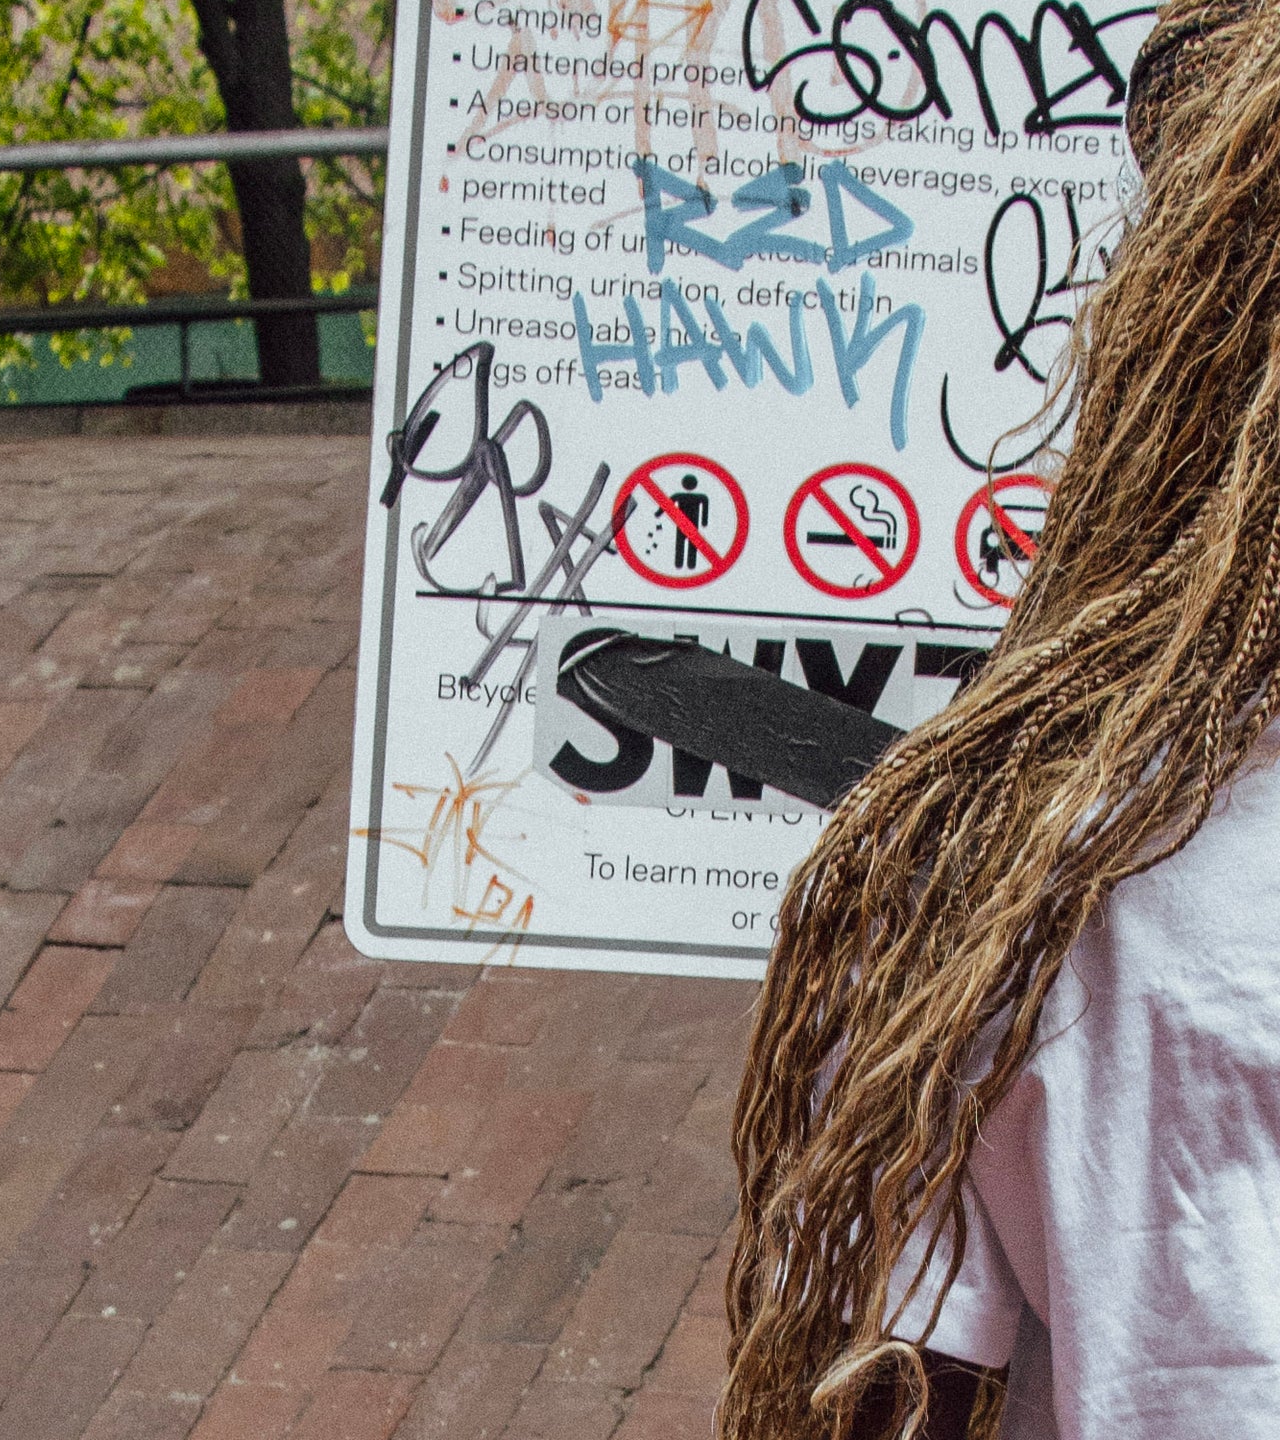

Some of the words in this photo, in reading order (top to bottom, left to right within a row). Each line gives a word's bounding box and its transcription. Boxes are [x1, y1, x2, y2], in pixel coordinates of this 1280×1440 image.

[471, 44, 645, 81] Unattended
[467, 90, 488, 115] A
[497, 98, 597, 124] person
[605, 103, 634, 122] or
[643, 98, 711, 129] their
[717, 105, 876, 144] belongings
[885, 116, 974, 153] taking
[983, 129, 1019, 154] up
[1026, 132, 1100, 155] more
[465, 134, 658, 172] Consumption
[667, 148, 696, 174] of
[1010, 173, 1108, 204] except
[462, 177, 606, 205] permitted
[460, 217, 576, 255] Feeding
[584, 225, 613, 252] of
[866, 245, 979, 275] animals
[591, 277, 727, 307] urinaion,
[452, 353, 527, 388] Dgs
[583, 853, 616, 881] To
[624, 854, 697, 885] learn
[705, 865, 780, 891] more
[731, 909, 762, 931] or
